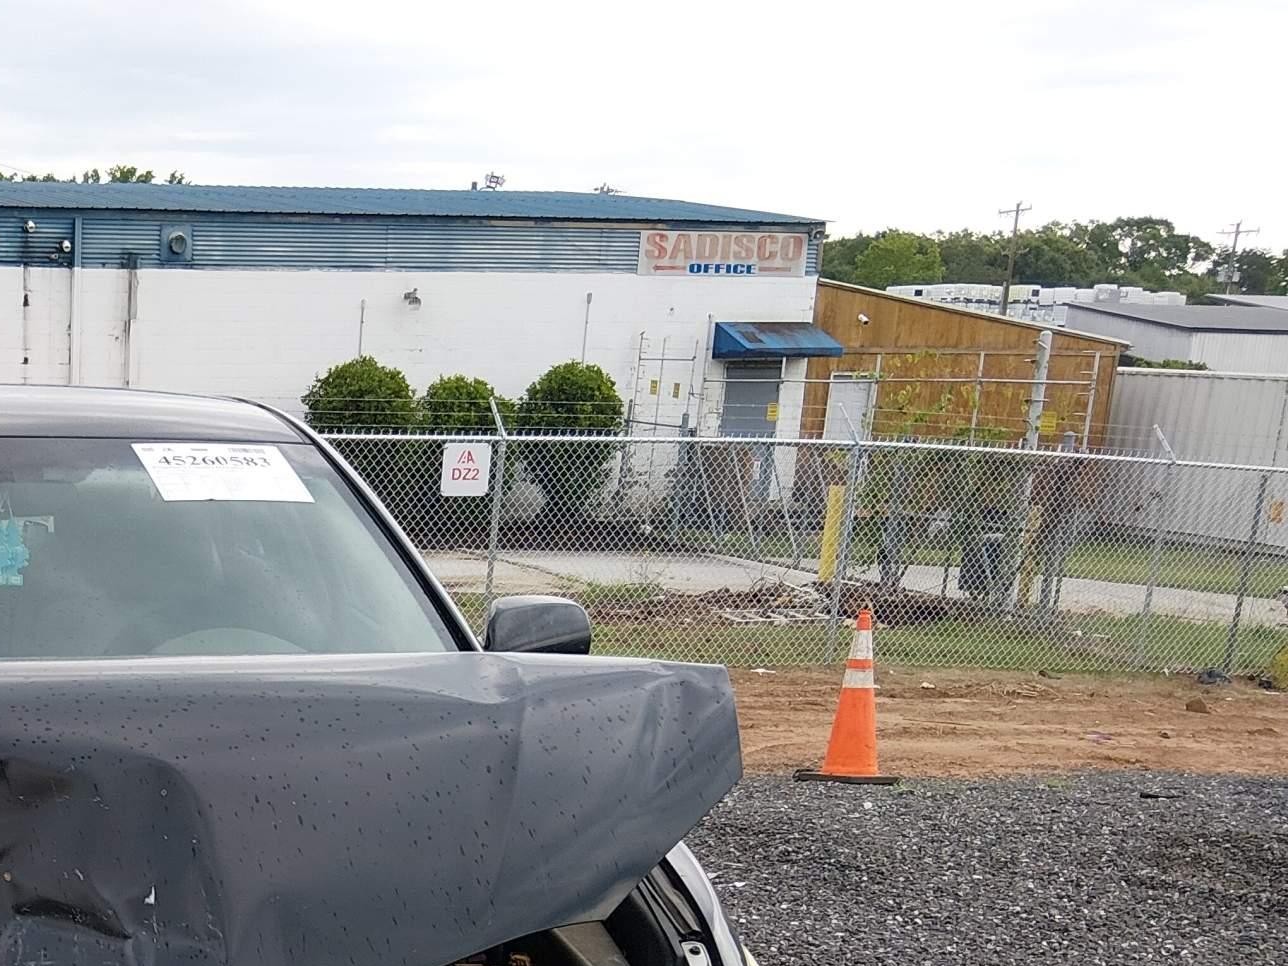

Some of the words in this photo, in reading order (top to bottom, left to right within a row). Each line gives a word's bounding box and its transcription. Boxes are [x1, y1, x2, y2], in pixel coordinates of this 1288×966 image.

[644, 232, 804, 261] SADISCO
[688, 263, 756, 275] OFFICE
[158, 455, 271, 467] 45260583
[451, 467, 480, 481] DZ2
